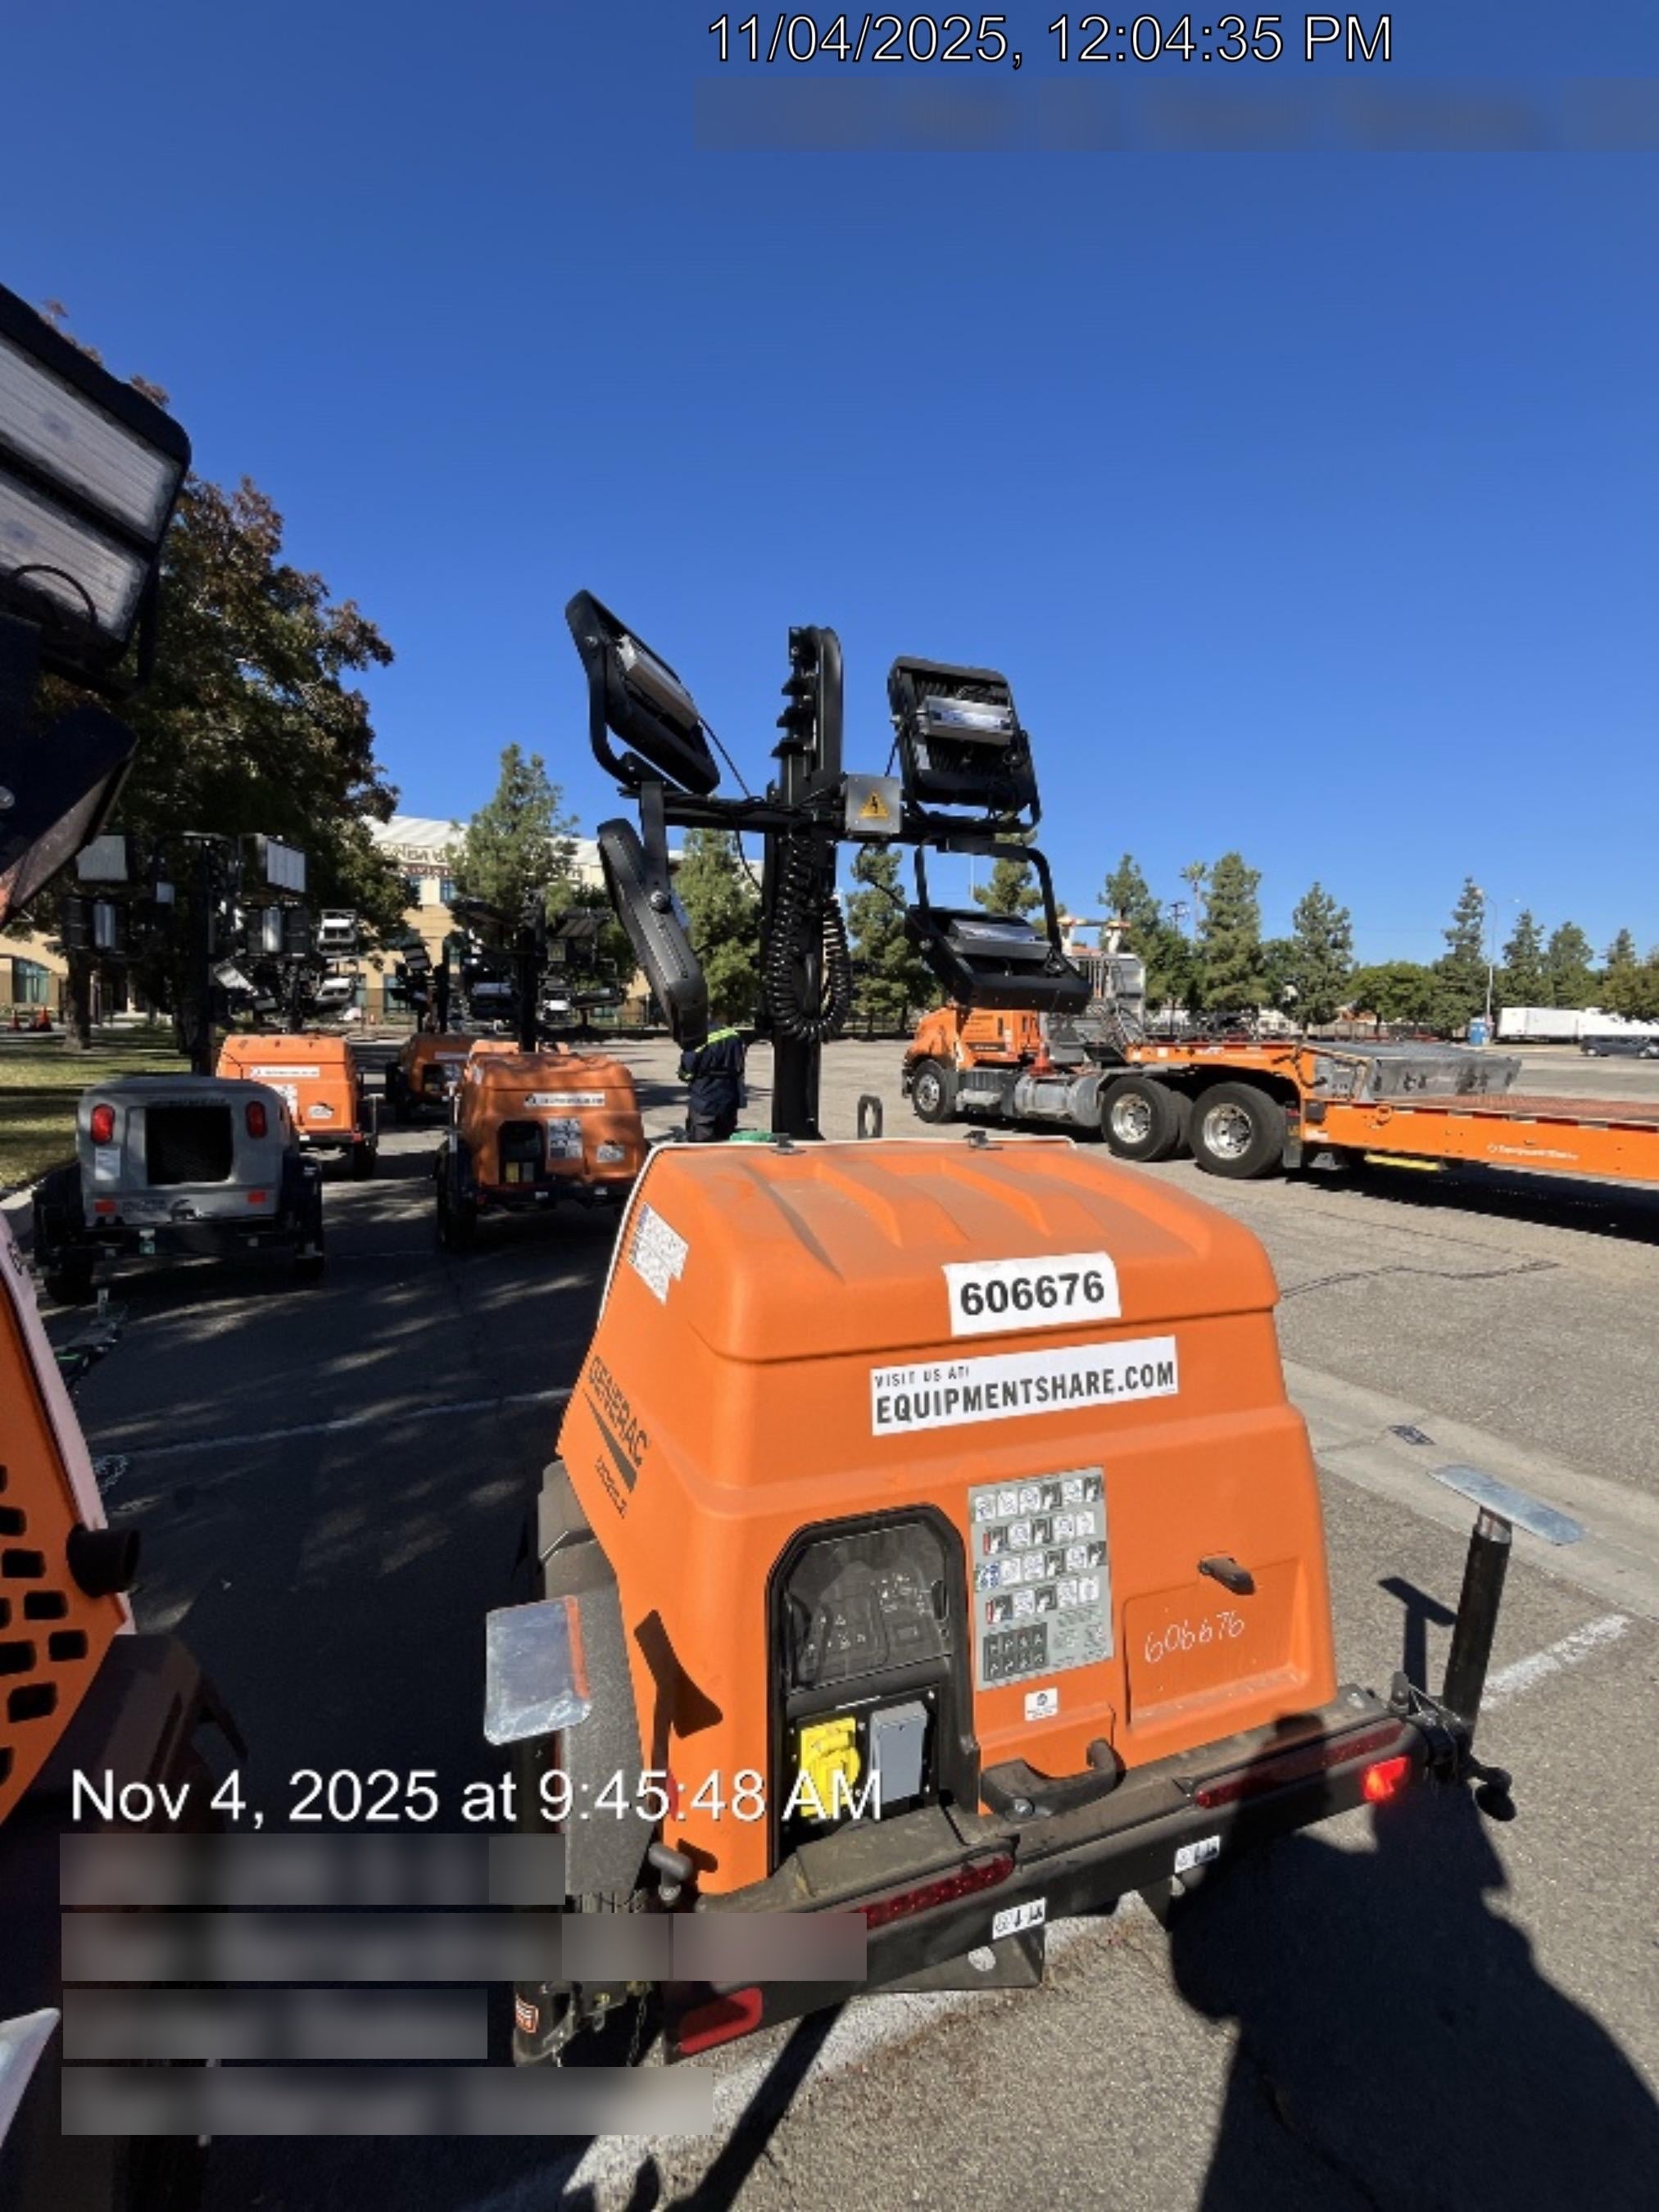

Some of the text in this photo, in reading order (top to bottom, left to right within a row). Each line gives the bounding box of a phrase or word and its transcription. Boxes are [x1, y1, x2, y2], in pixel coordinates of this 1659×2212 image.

[960, 1271, 1105, 1316] 606676
[874, 1371, 916, 1388] VISIT
[923, 1368, 941, 1382] US
[876, 1361, 1175, 1425] EQUIPMENTSHARE.COM
[1145, 1610, 1245, 1664] 606676
